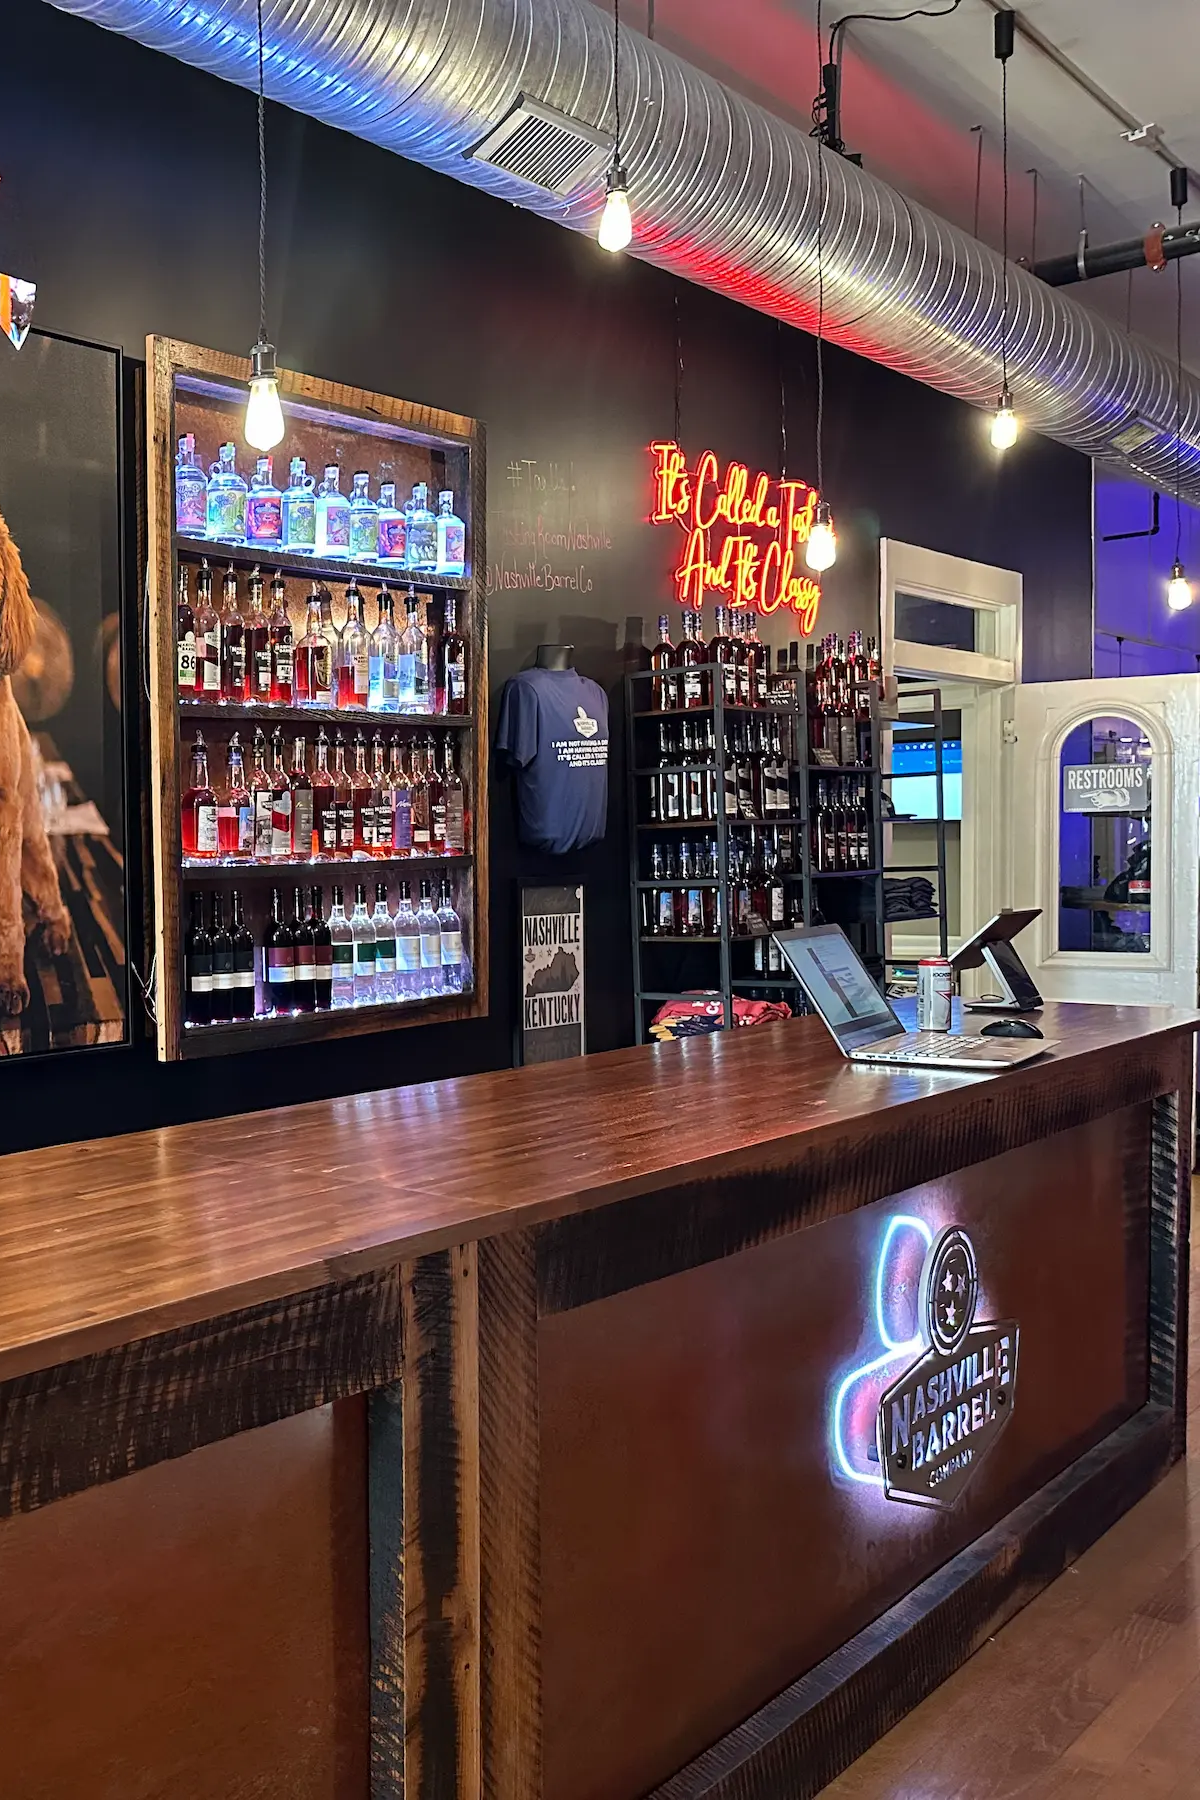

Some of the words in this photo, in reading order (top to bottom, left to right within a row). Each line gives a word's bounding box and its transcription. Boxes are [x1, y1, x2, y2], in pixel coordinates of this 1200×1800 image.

[653, 444, 691, 521] It's
[696, 453, 766, 530] Called
[766, 505, 781, 529] a
[679, 528, 732, 607] And
[760, 541, 822, 634] Classy
[568, 760, 582, 768] AND
[1067, 767, 1143, 790] RESTROOMS
[524, 914, 581, 947] NASHVILLE
[524, 993, 581, 1029] KENTUCKY
[890, 1335, 1011, 1456] NASHVILLE
[910, 1388, 997, 1472] BARREL
[926, 1447, 976, 1488] COMPANY
